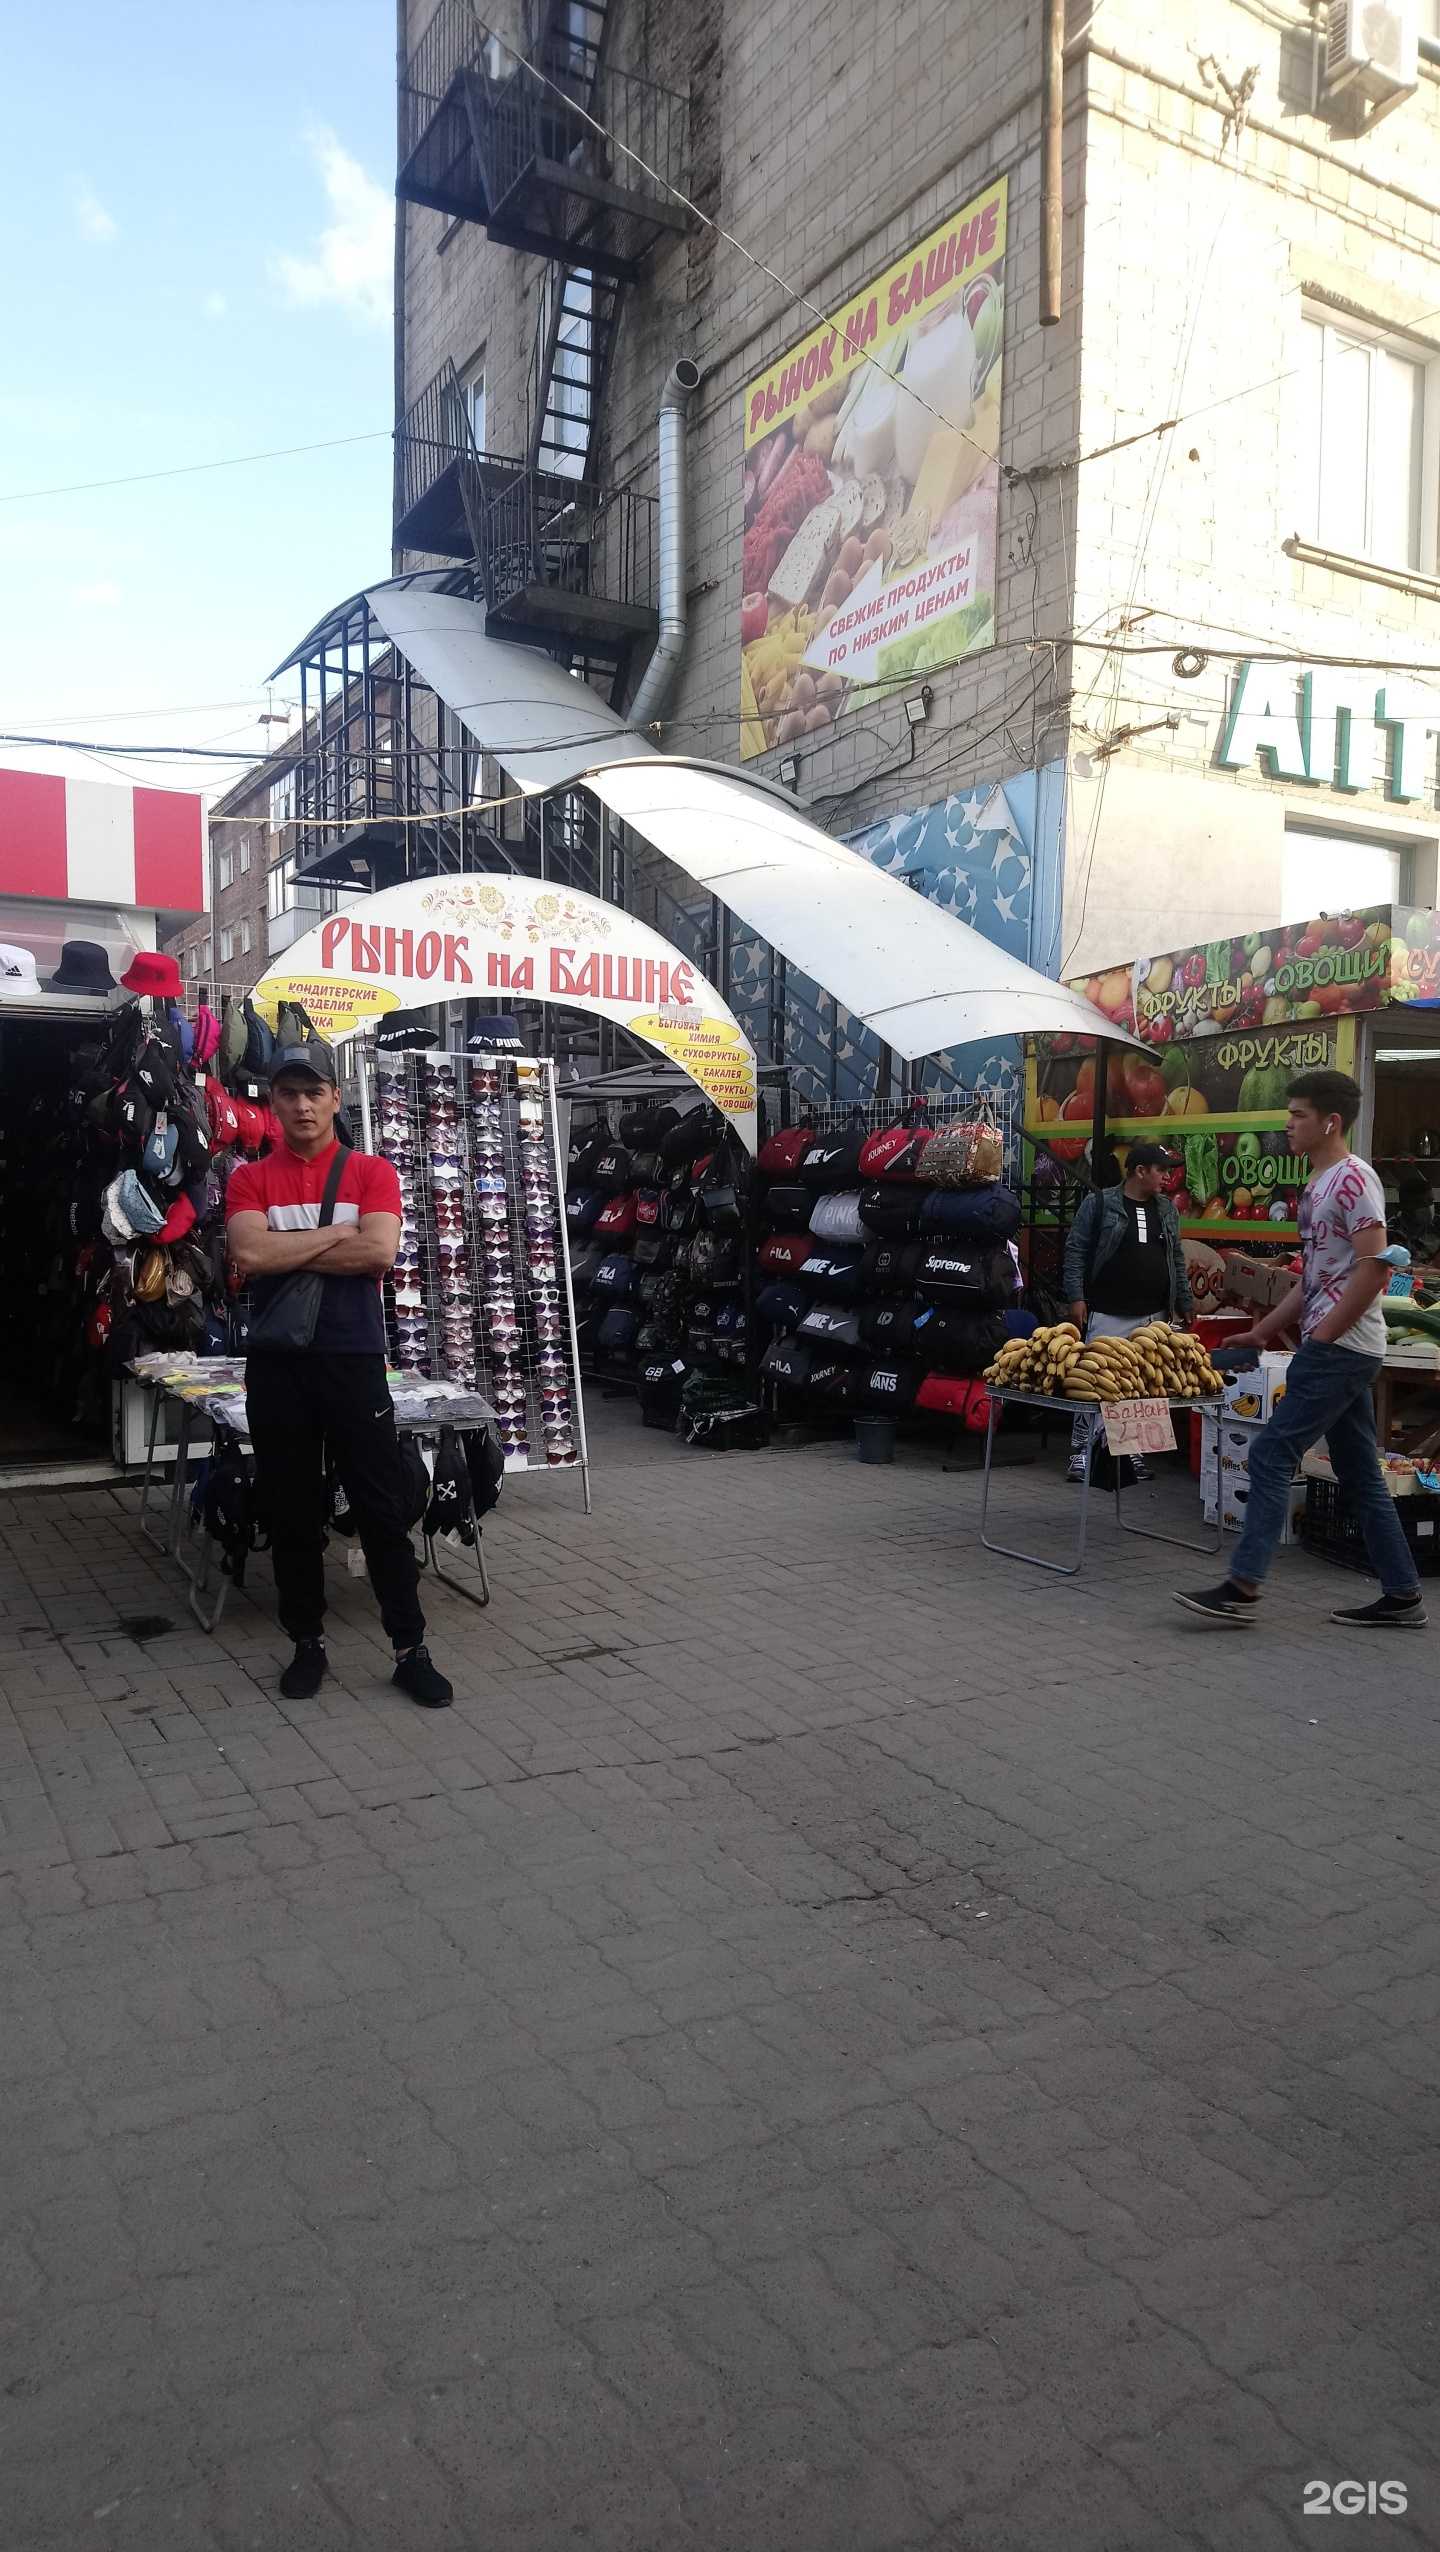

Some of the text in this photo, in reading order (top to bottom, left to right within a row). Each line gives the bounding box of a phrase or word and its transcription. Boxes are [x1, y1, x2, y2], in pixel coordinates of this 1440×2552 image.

[750, 198, 1000, 434] РЫНОК НА БАШНЕ
[829, 547, 971, 639] СВЕЖИЕ ПРОДУКТЫ
[829, 578, 969, 666] ПО НИЗКИМ ЦЕНАМ
[1143, 940, 1391, 1018] ФРУКТЫ ОВОЩИ
[288, 982, 378, 1001] КОНДИТЕРСКИЕ
[299, 996, 353, 1012] ИЗДЕЛИЯ
[688, 1031, 720, 1044] ХИМИЯ
[682, 1049, 740, 1062] СУХОФРУКТЫ
[1217, 1032, 1328, 1071] ФРУКТЫ
[703, 1067, 742, 1079] БАКАЛЕЯ
[711, 1085, 748, 1095] ФРУКТЫ
[723, 1098, 753, 1109] ОВОЩИ
[824, 1205, 856, 1225] PINK
[924, 1255, 972, 1274] Supreme
[870, 1369, 898, 1392] VANS
